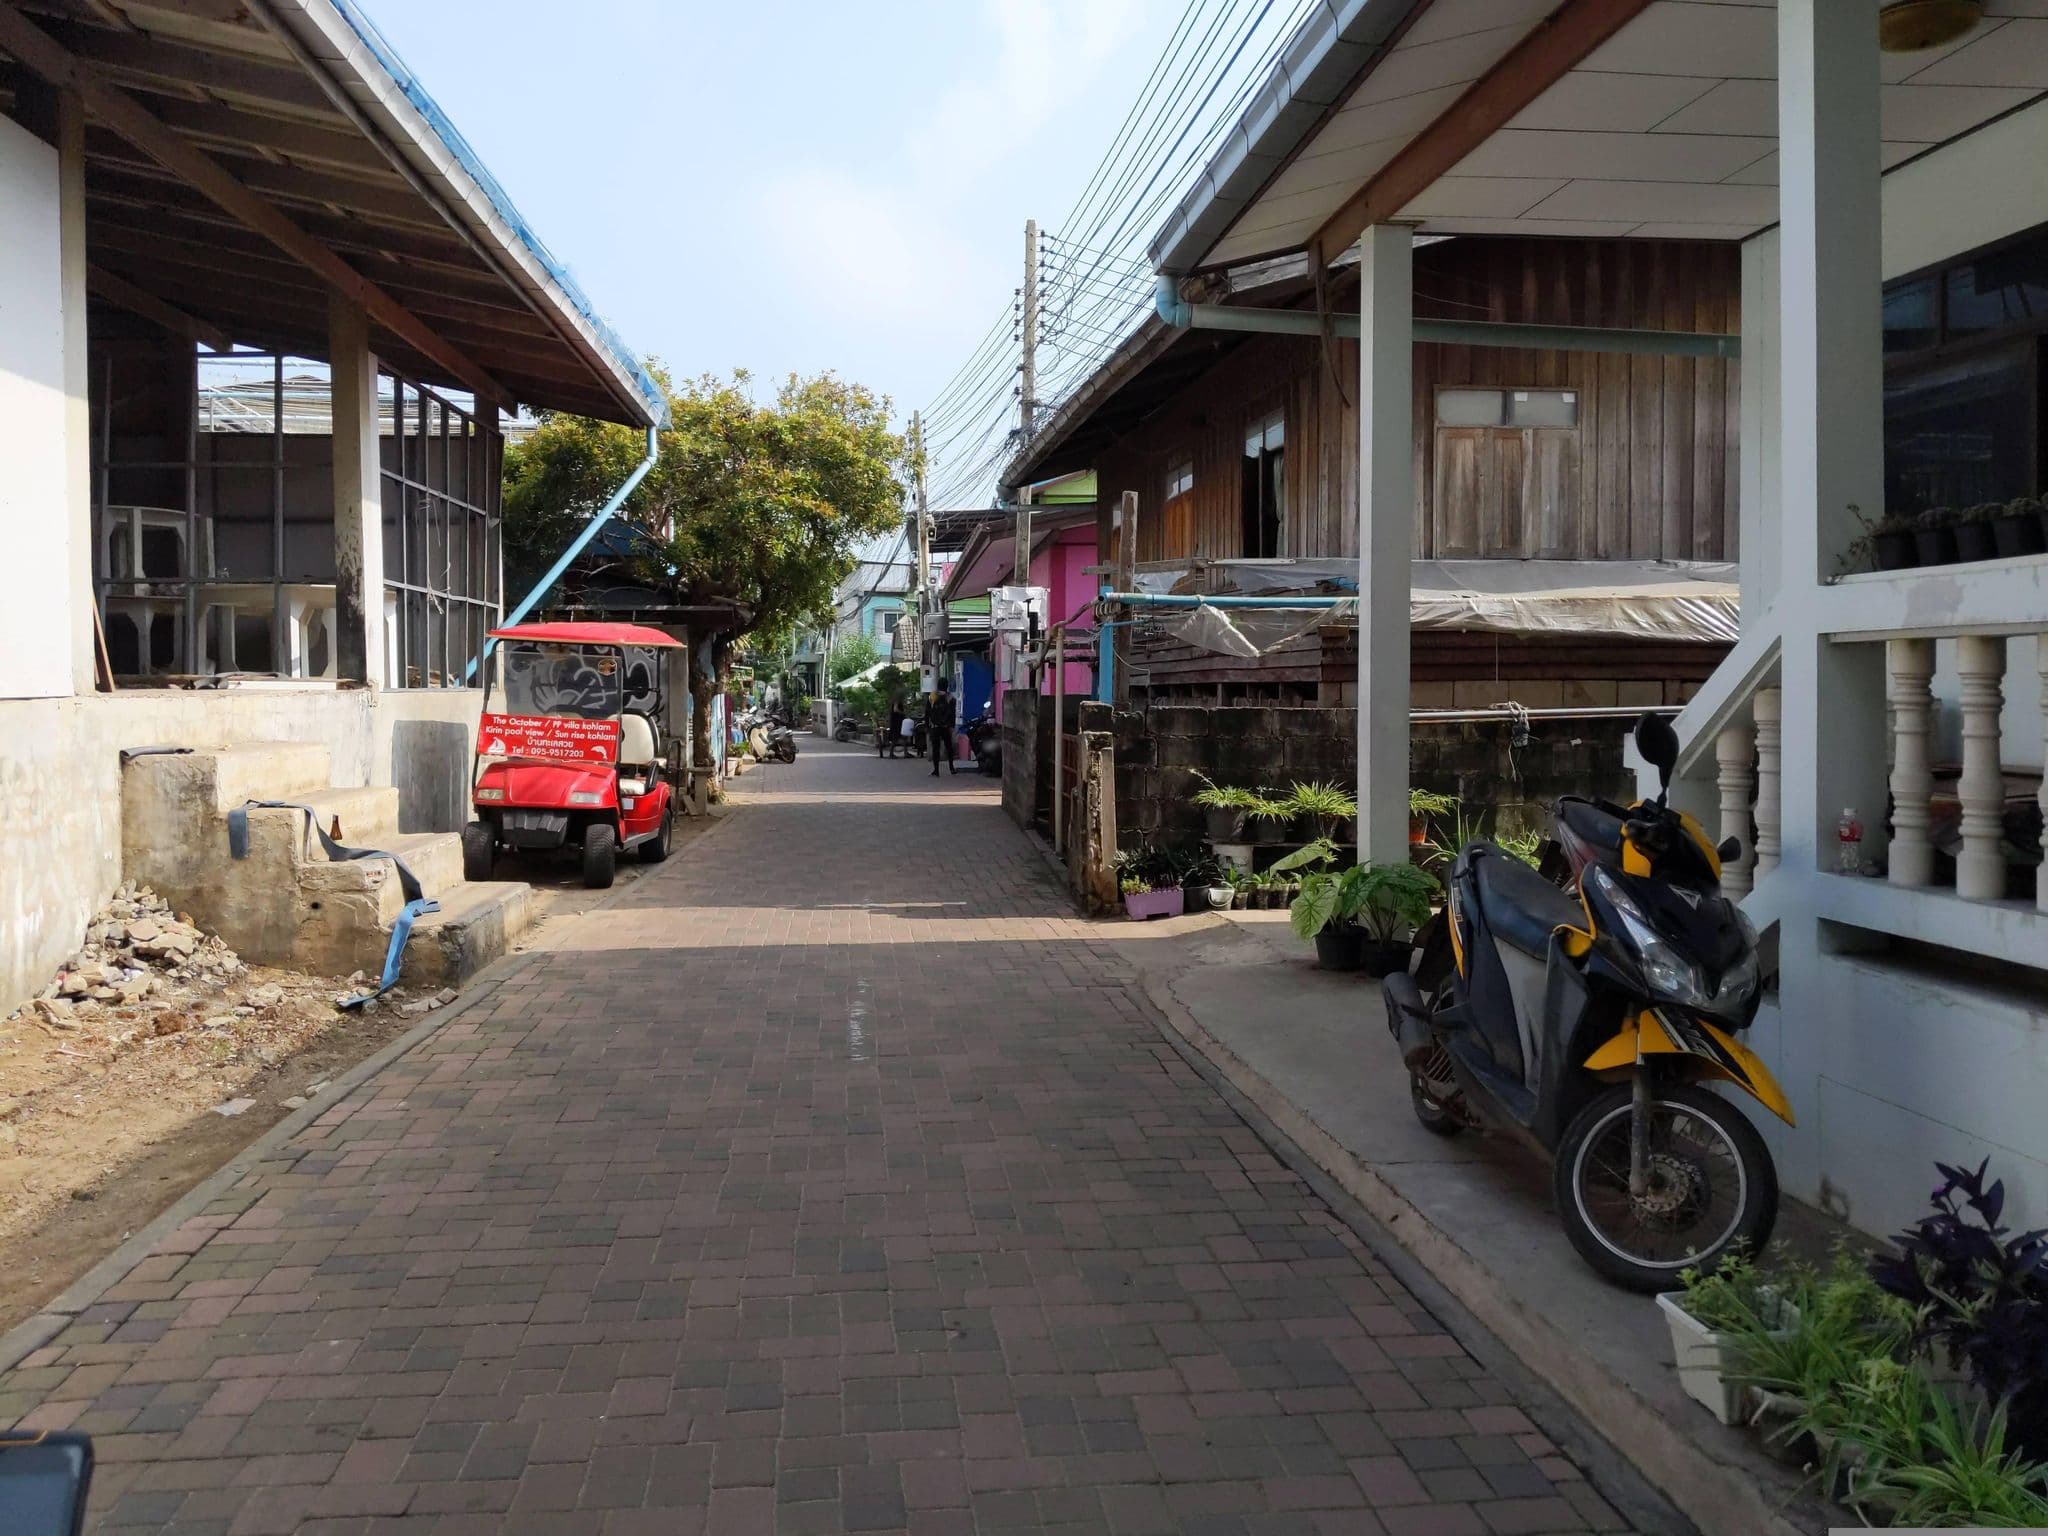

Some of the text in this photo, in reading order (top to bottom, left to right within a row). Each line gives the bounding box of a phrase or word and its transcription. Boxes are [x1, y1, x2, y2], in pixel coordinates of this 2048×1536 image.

[493, 716, 507, 725] The
[509, 717, 542, 727] October
[563, 720, 580, 730] villa
[485, 725, 503, 735] Kirin
[504, 727, 523, 737] pool
[525, 728, 545, 737] view
[555, 730, 569, 738] Sun
[570, 730, 585, 739] rise
[511, 745, 524, 754] Tel
[530, 747, 584, 758] 095-9517203
